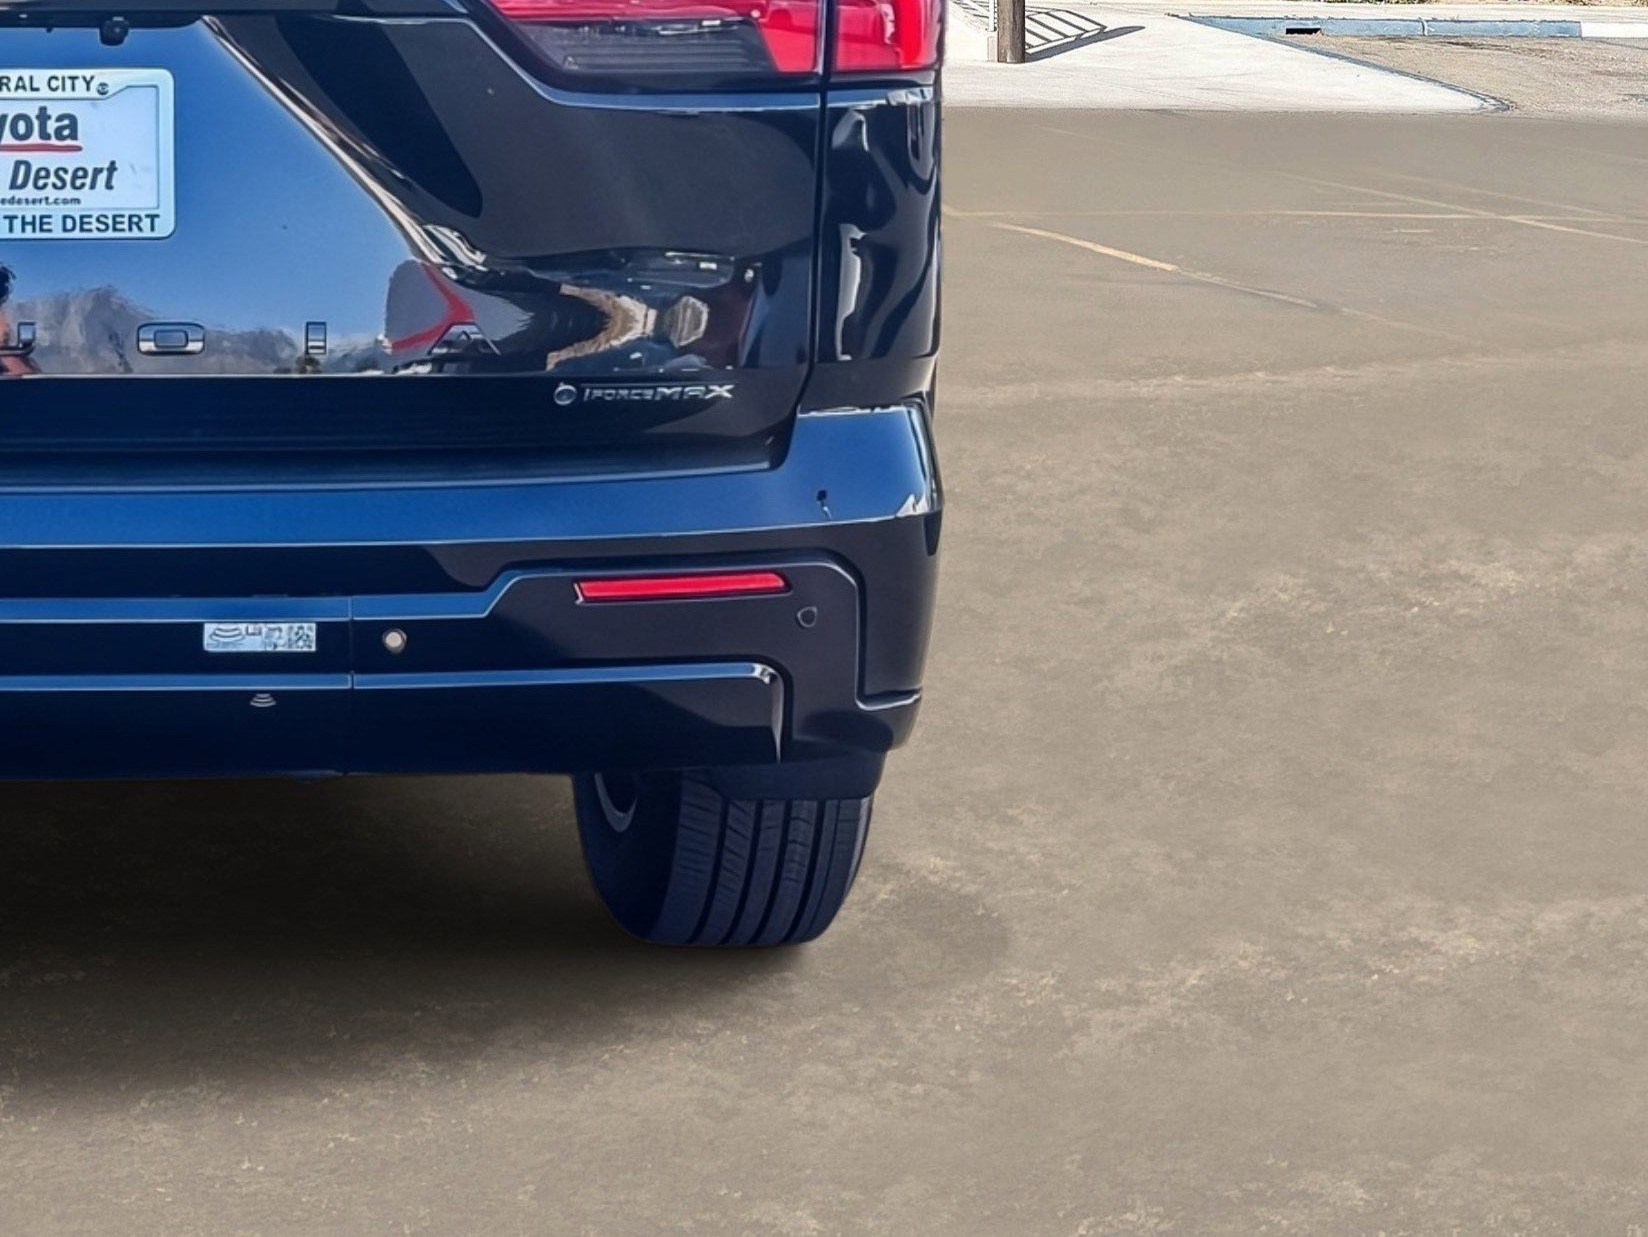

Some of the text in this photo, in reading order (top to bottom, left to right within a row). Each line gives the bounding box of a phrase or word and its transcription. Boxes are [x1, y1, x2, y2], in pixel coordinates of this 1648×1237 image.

[47, 75, 96, 93] CITY
[8, 159, 118, 191] Desert
[3, 214, 53, 234] THE
[61, 213, 160, 233] DESERT
